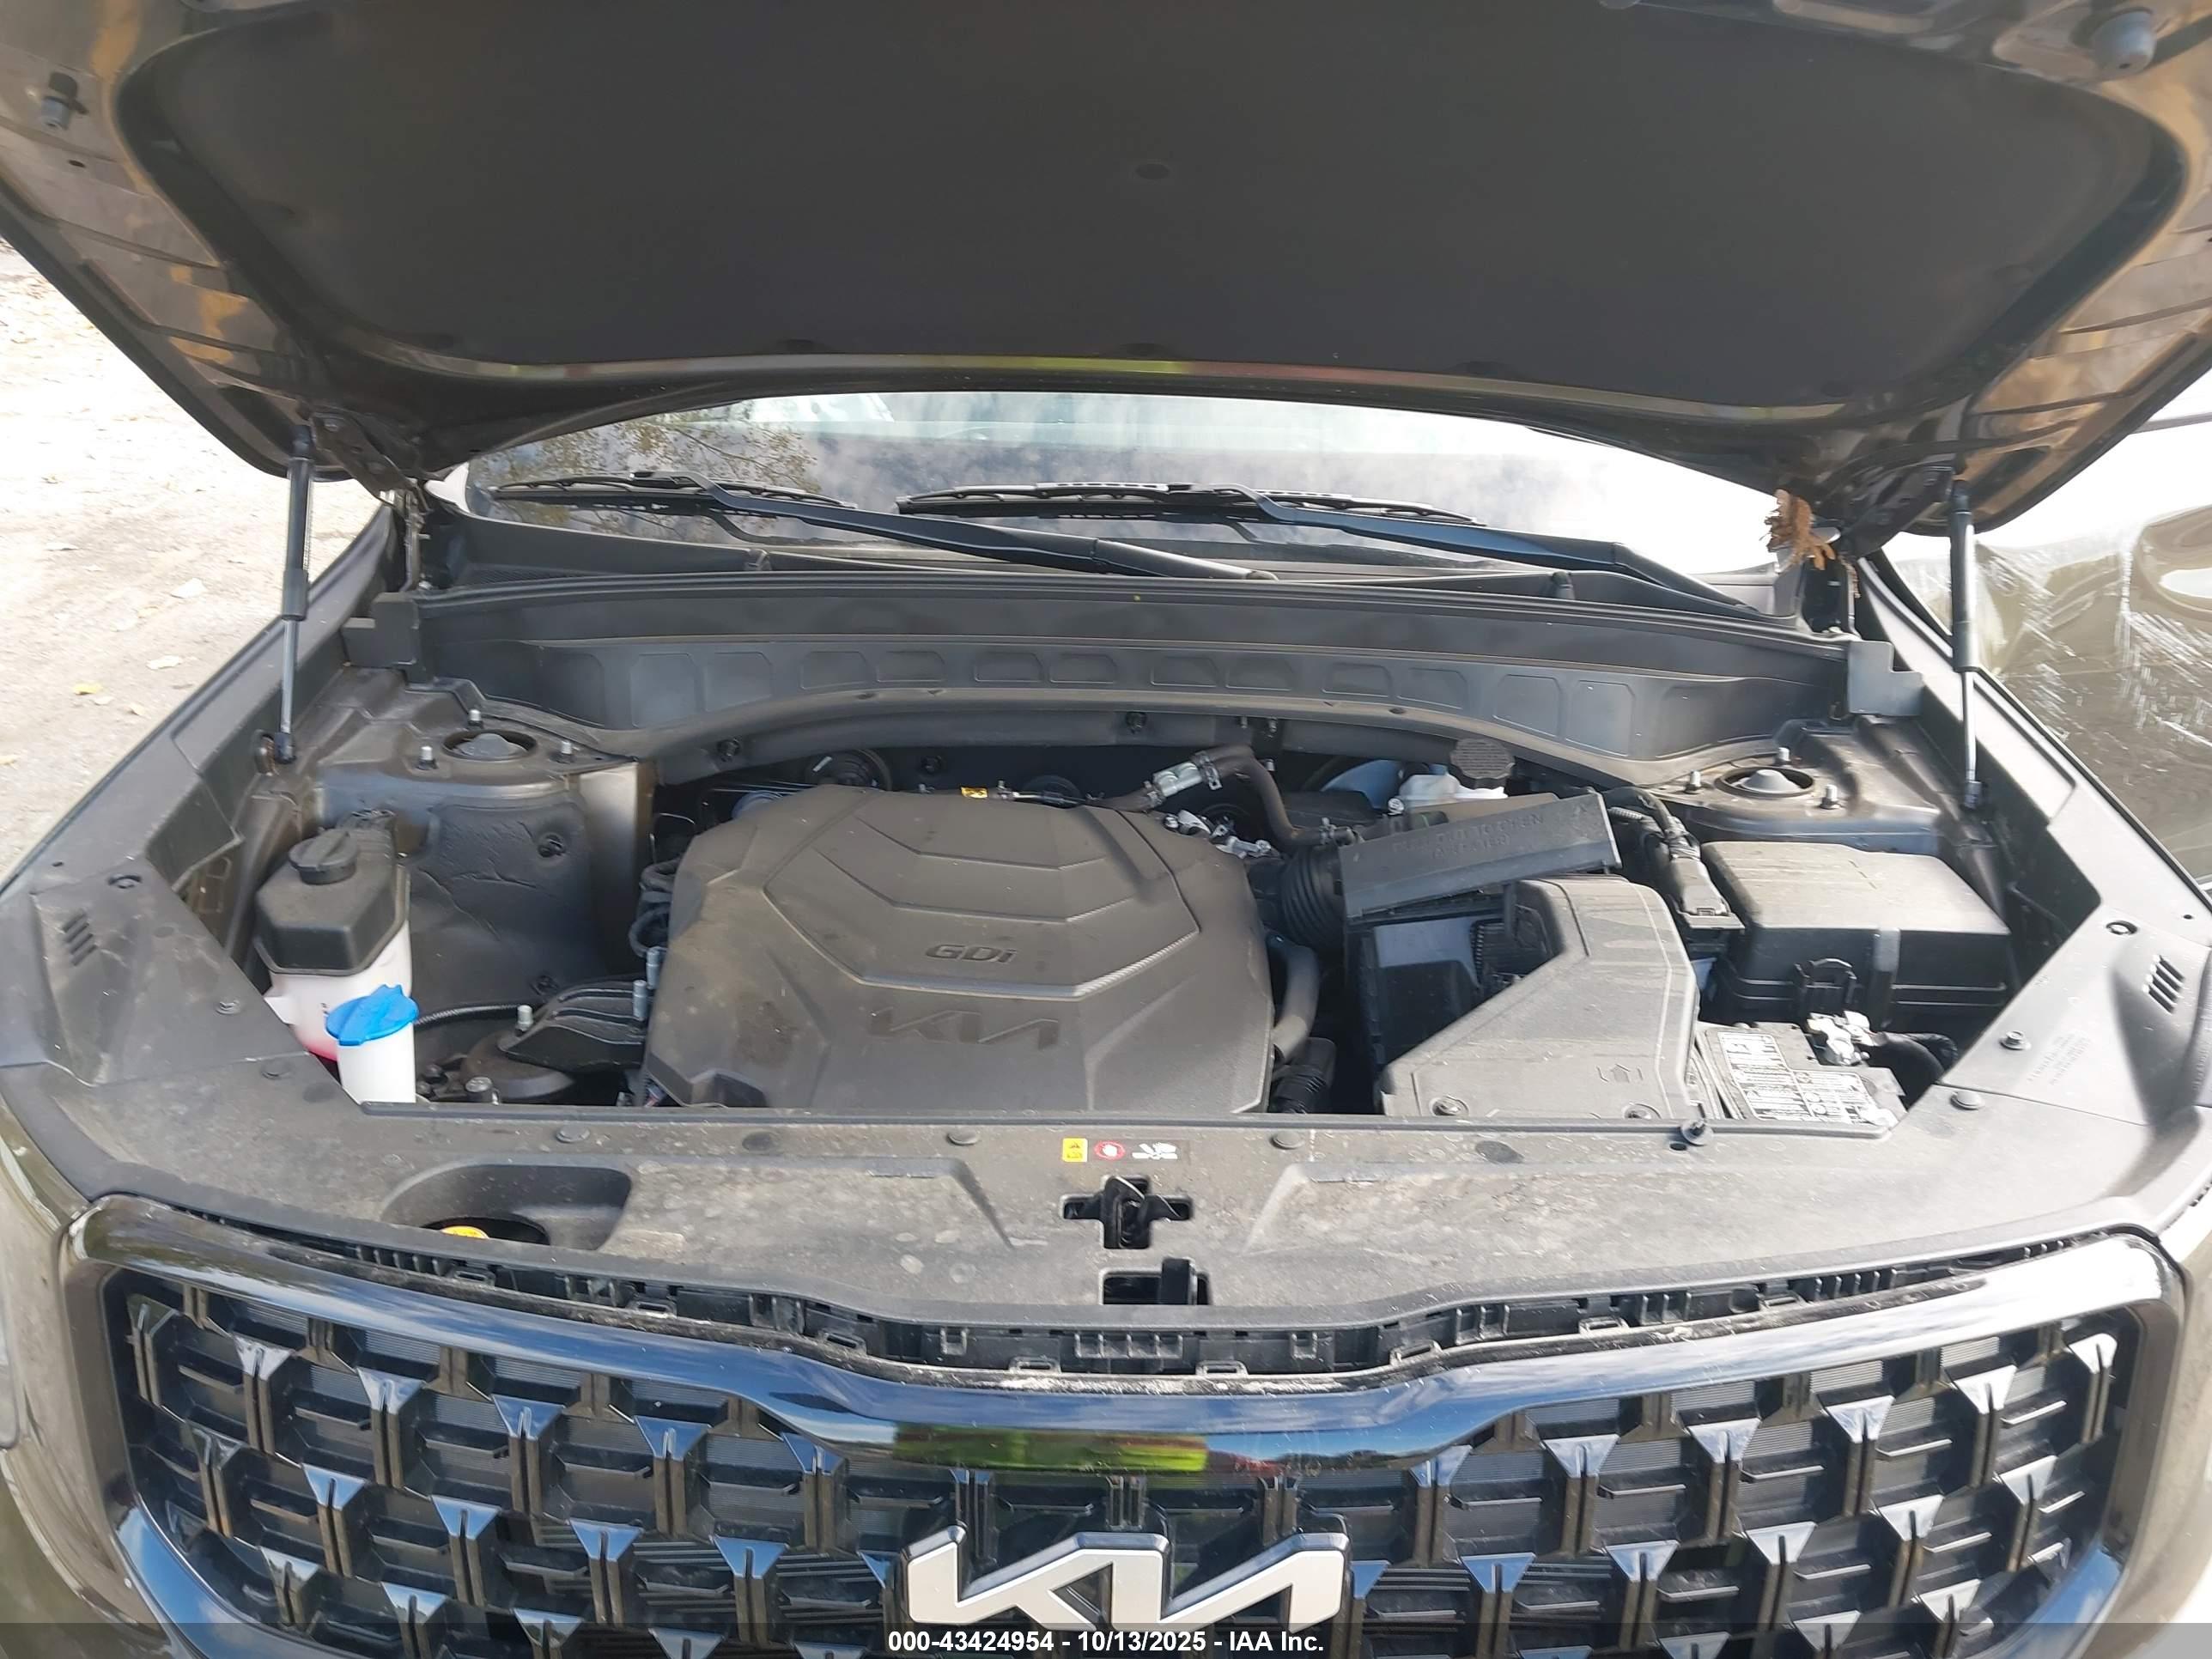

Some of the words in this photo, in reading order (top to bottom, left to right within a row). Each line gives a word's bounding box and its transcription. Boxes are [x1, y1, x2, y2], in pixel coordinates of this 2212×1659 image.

[924, 944, 1018, 963] GDi
[869, 1006, 1060, 1050] KIA
[902, 1525, 1350, 1633] KIA
